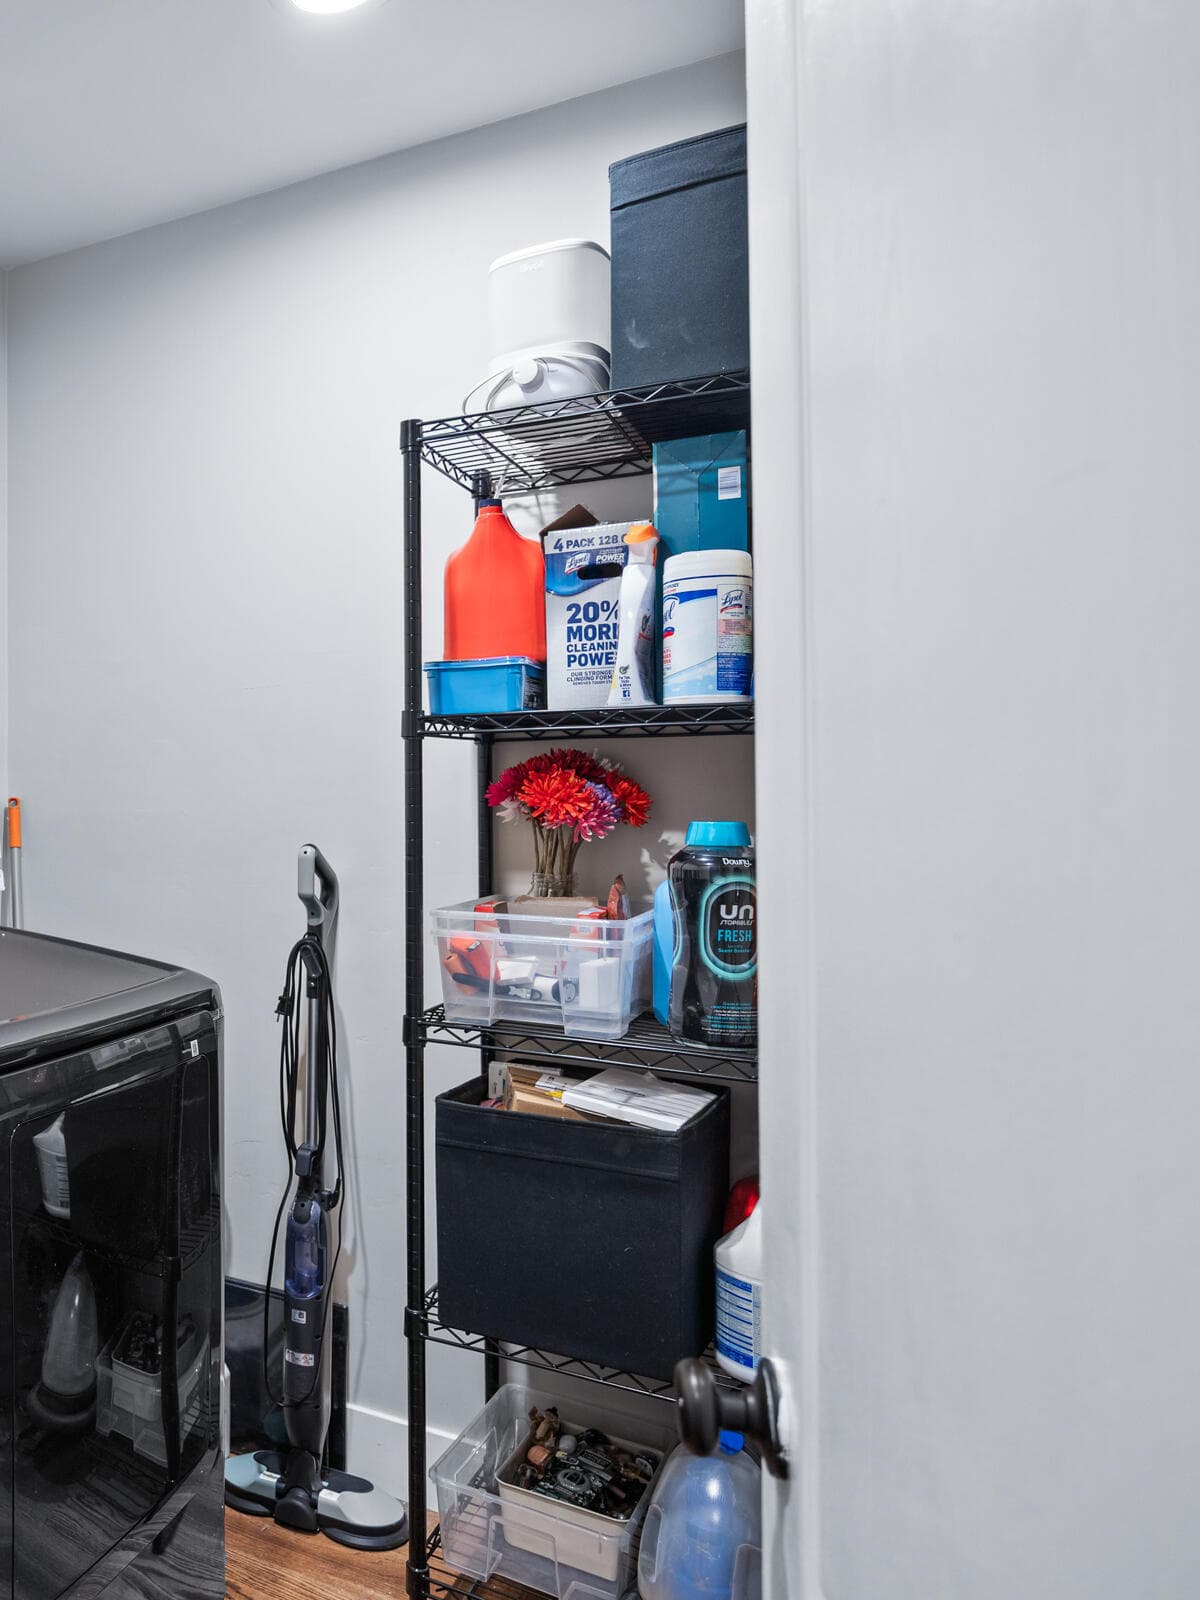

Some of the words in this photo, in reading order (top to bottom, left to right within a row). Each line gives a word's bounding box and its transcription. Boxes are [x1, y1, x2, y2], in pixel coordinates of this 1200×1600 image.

[553, 537, 564, 552] 4
[566, 537, 595, 549] PACK
[598, 534, 619, 546] 128
[596, 552, 625, 562] POWER
[566, 600, 619, 624] 20%
[566, 641, 617, 653] CLEANIN
[567, 651, 617, 667] POWE
[722, 858, 750, 867] Downy
[717, 929, 752, 942] FRESH
